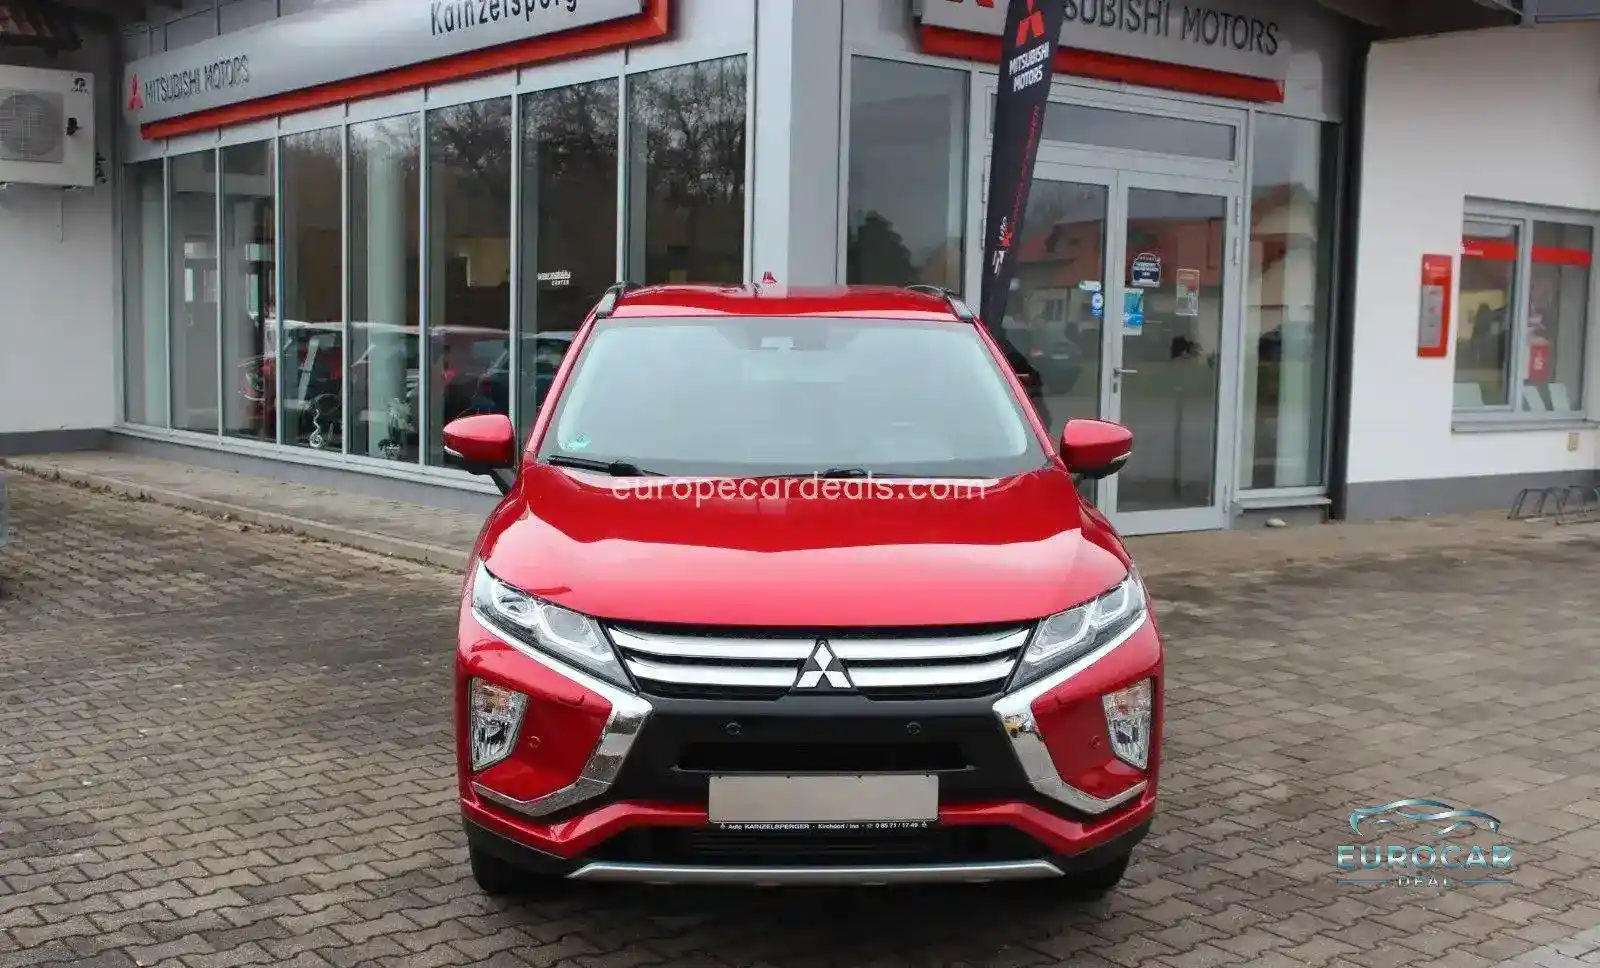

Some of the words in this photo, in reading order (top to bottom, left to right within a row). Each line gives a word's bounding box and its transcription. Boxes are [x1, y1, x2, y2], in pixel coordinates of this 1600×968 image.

[1062, 0, 1169, 36] SUBISHI
[1181, 6, 1278, 55] MOTORS
[1009, 41, 1049, 75] MITSUBISHI
[1014, 64, 1043, 91] MOTORS
[145, 68, 200, 103] MITSUBISHI
[204, 55, 249, 91] MOTORS
